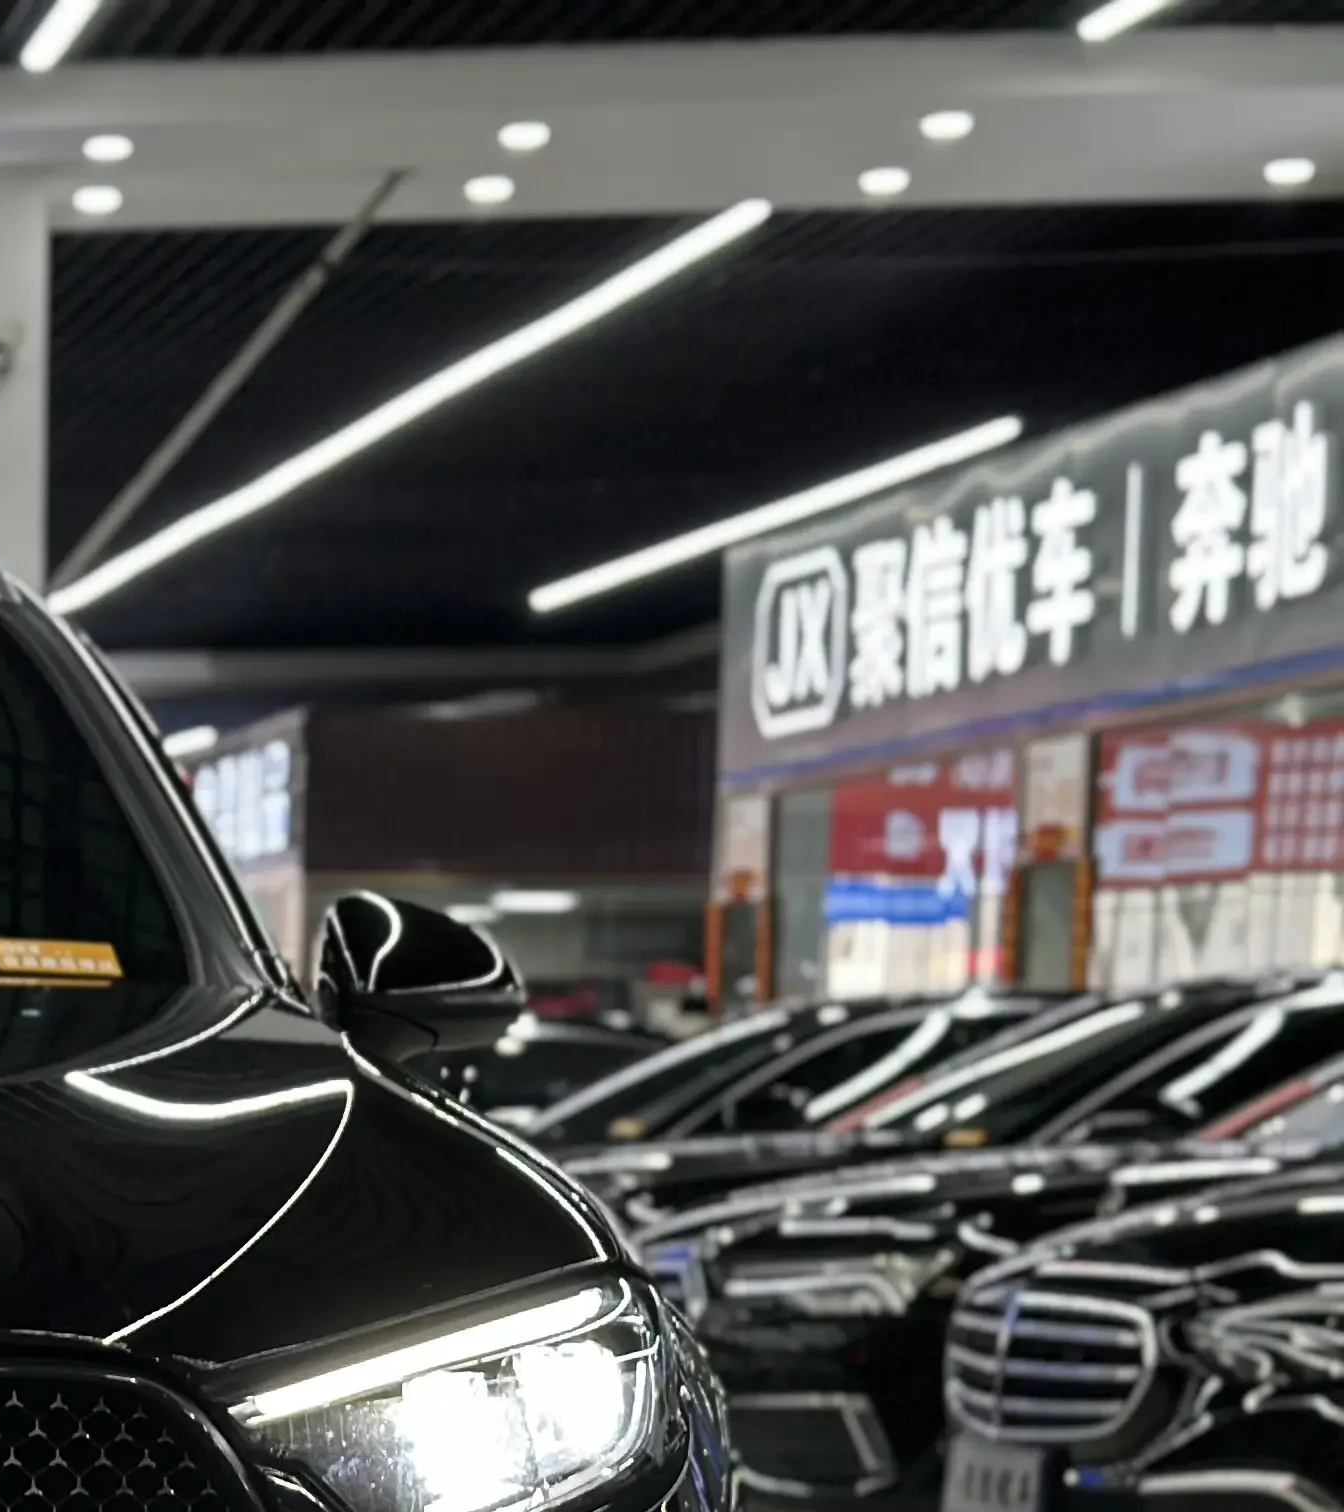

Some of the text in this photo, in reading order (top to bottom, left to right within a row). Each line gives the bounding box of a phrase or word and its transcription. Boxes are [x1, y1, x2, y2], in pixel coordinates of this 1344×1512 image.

[765, 400, 1328, 709] JX 聚信优车 奔驰
